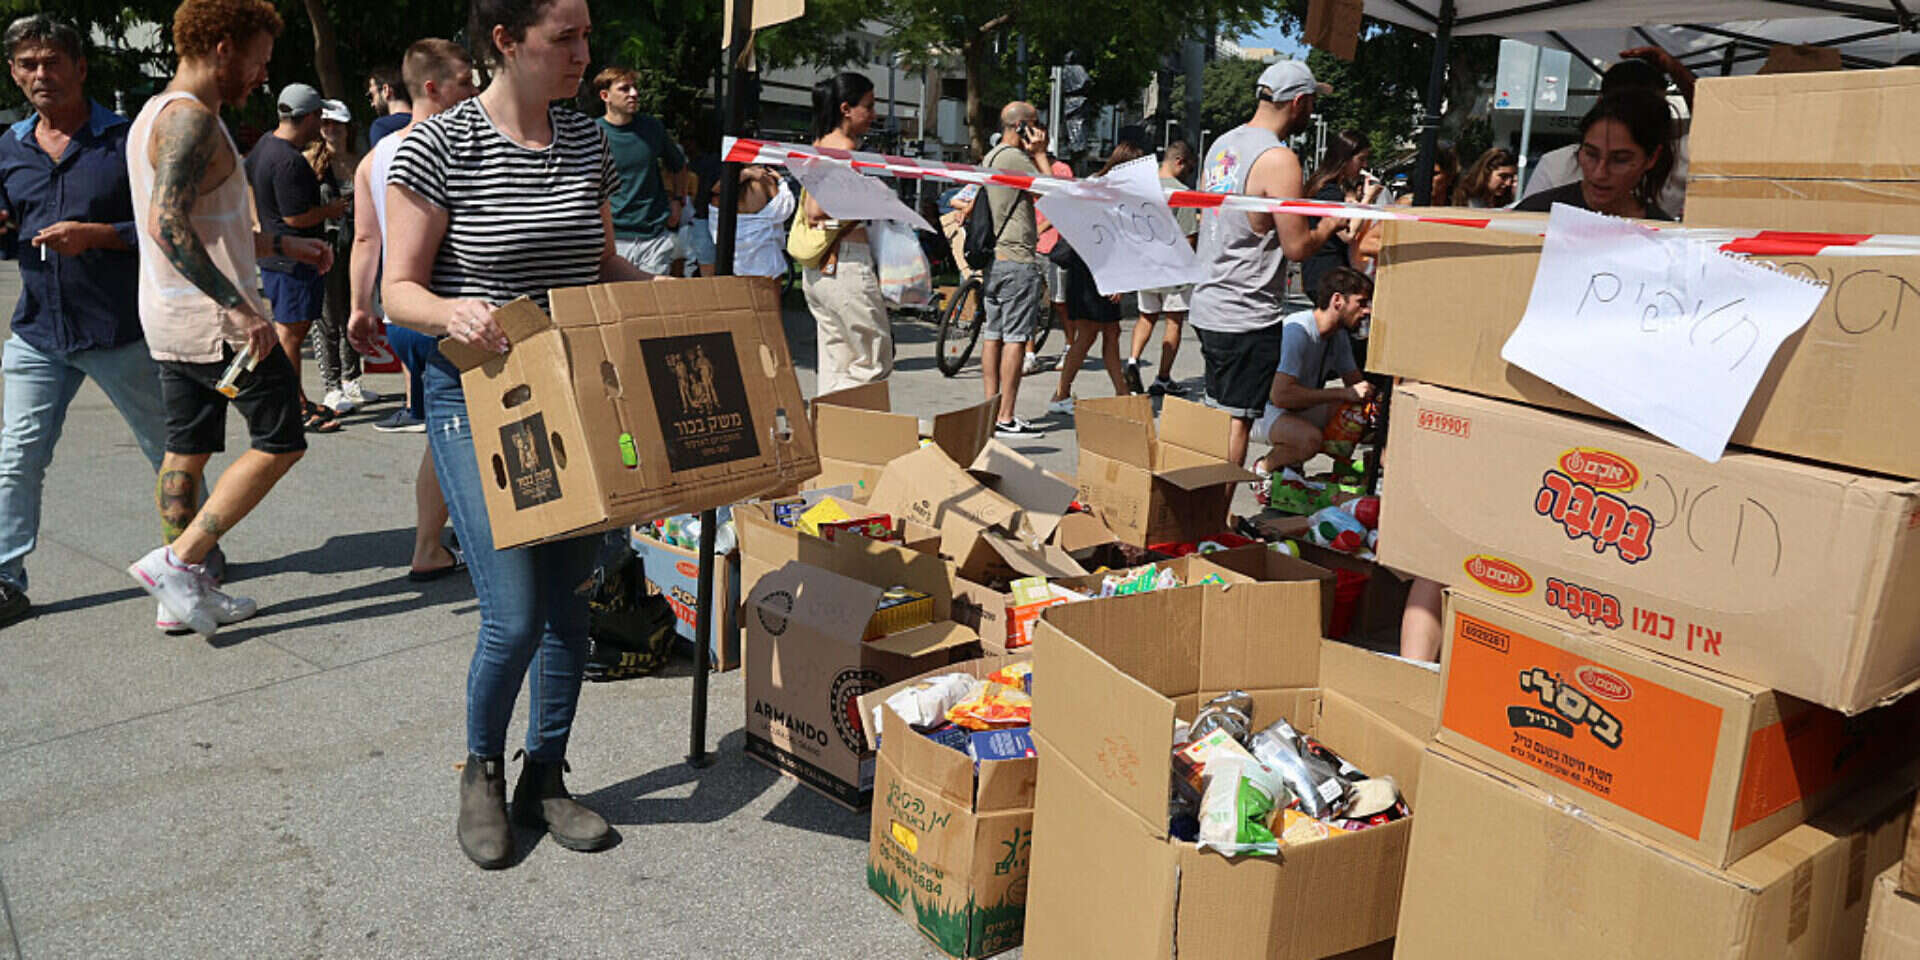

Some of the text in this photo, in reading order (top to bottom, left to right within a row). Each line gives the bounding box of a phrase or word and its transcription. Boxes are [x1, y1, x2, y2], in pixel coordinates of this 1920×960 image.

[672, 412, 743, 436] משק בכור
[1418, 408, 1470, 438] 6919901
[1486, 566, 1521, 586] אסם
[1632, 606, 1675, 641] כמו
[1687, 622, 1723, 657] אין
[754, 700, 828, 747] ARMANDO
[1519, 667, 1623, 750] ביסלי
[1524, 709, 1559, 730] גריל
